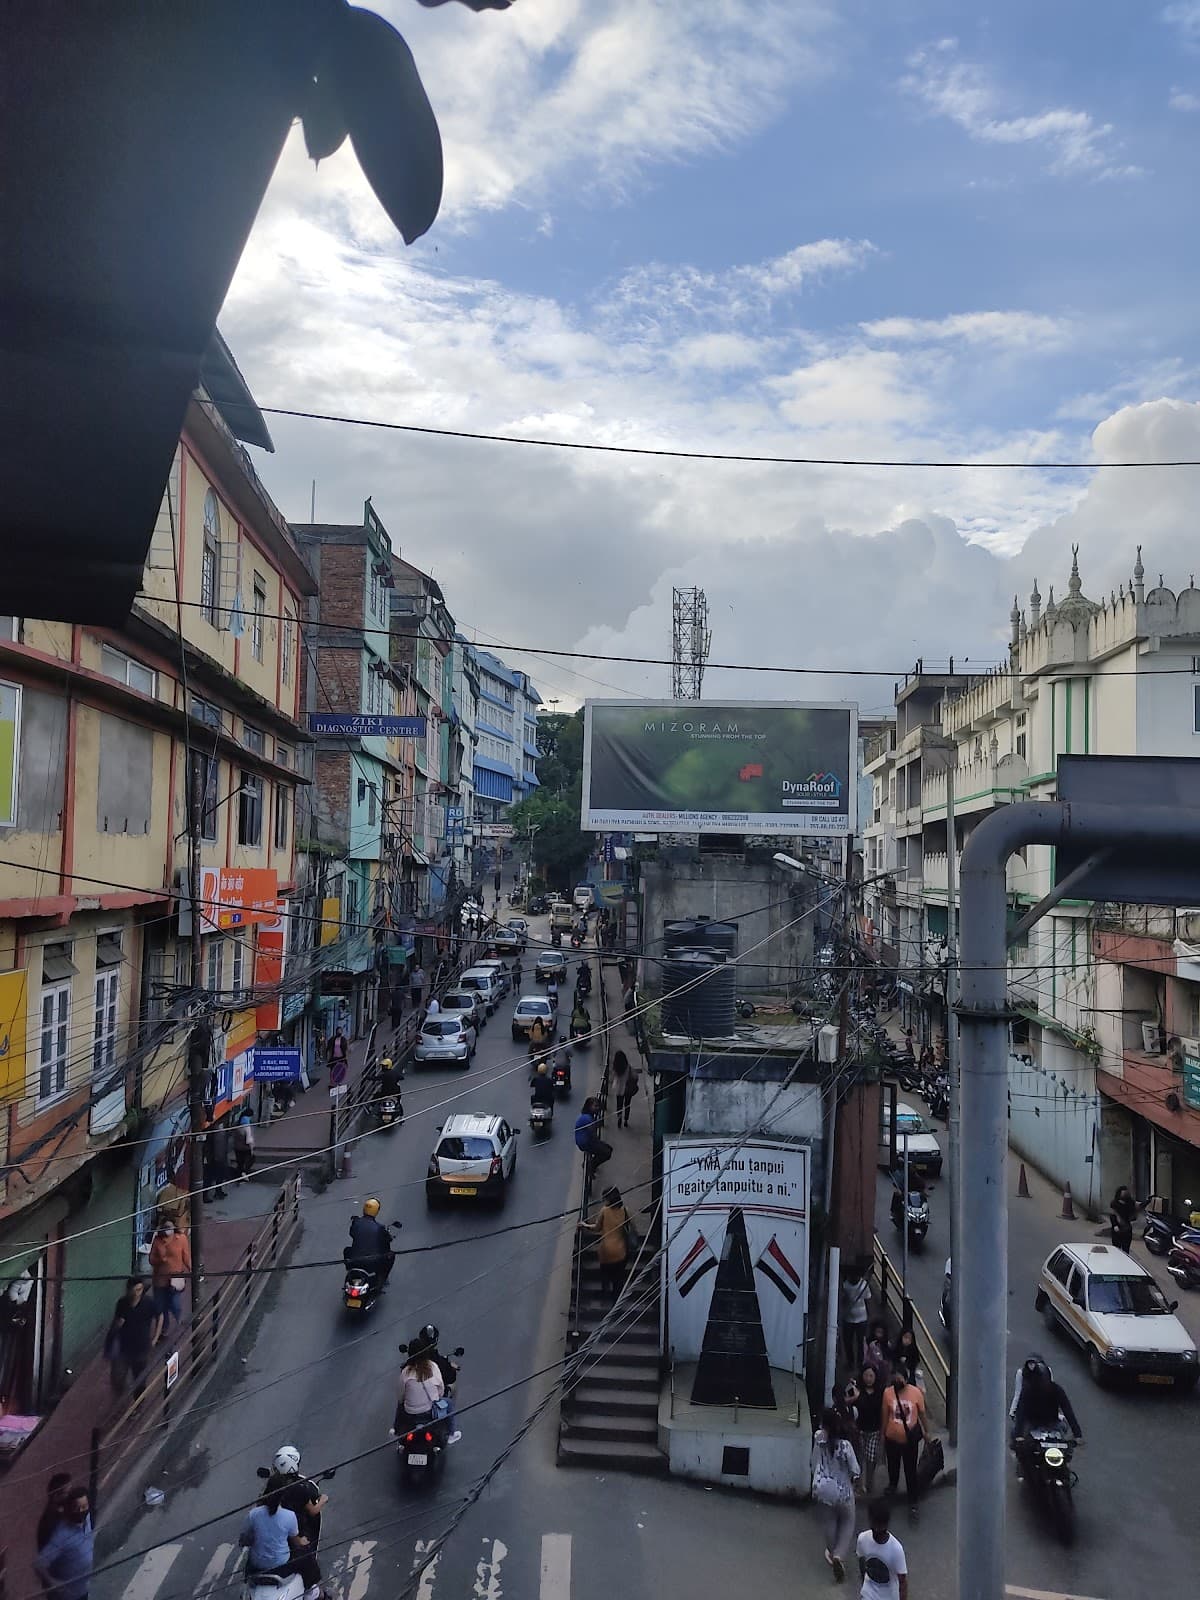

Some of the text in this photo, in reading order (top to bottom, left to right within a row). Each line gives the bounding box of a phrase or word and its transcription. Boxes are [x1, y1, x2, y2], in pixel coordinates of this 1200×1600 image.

[352, 717, 383, 725] ZIKI
[316, 724, 419, 735] DIAGNOSTIC CENTRE
[644, 722, 738, 732] MIZORAM
[782, 780, 835, 794] DynaRoof
[767, 1183, 774, 1194] a
